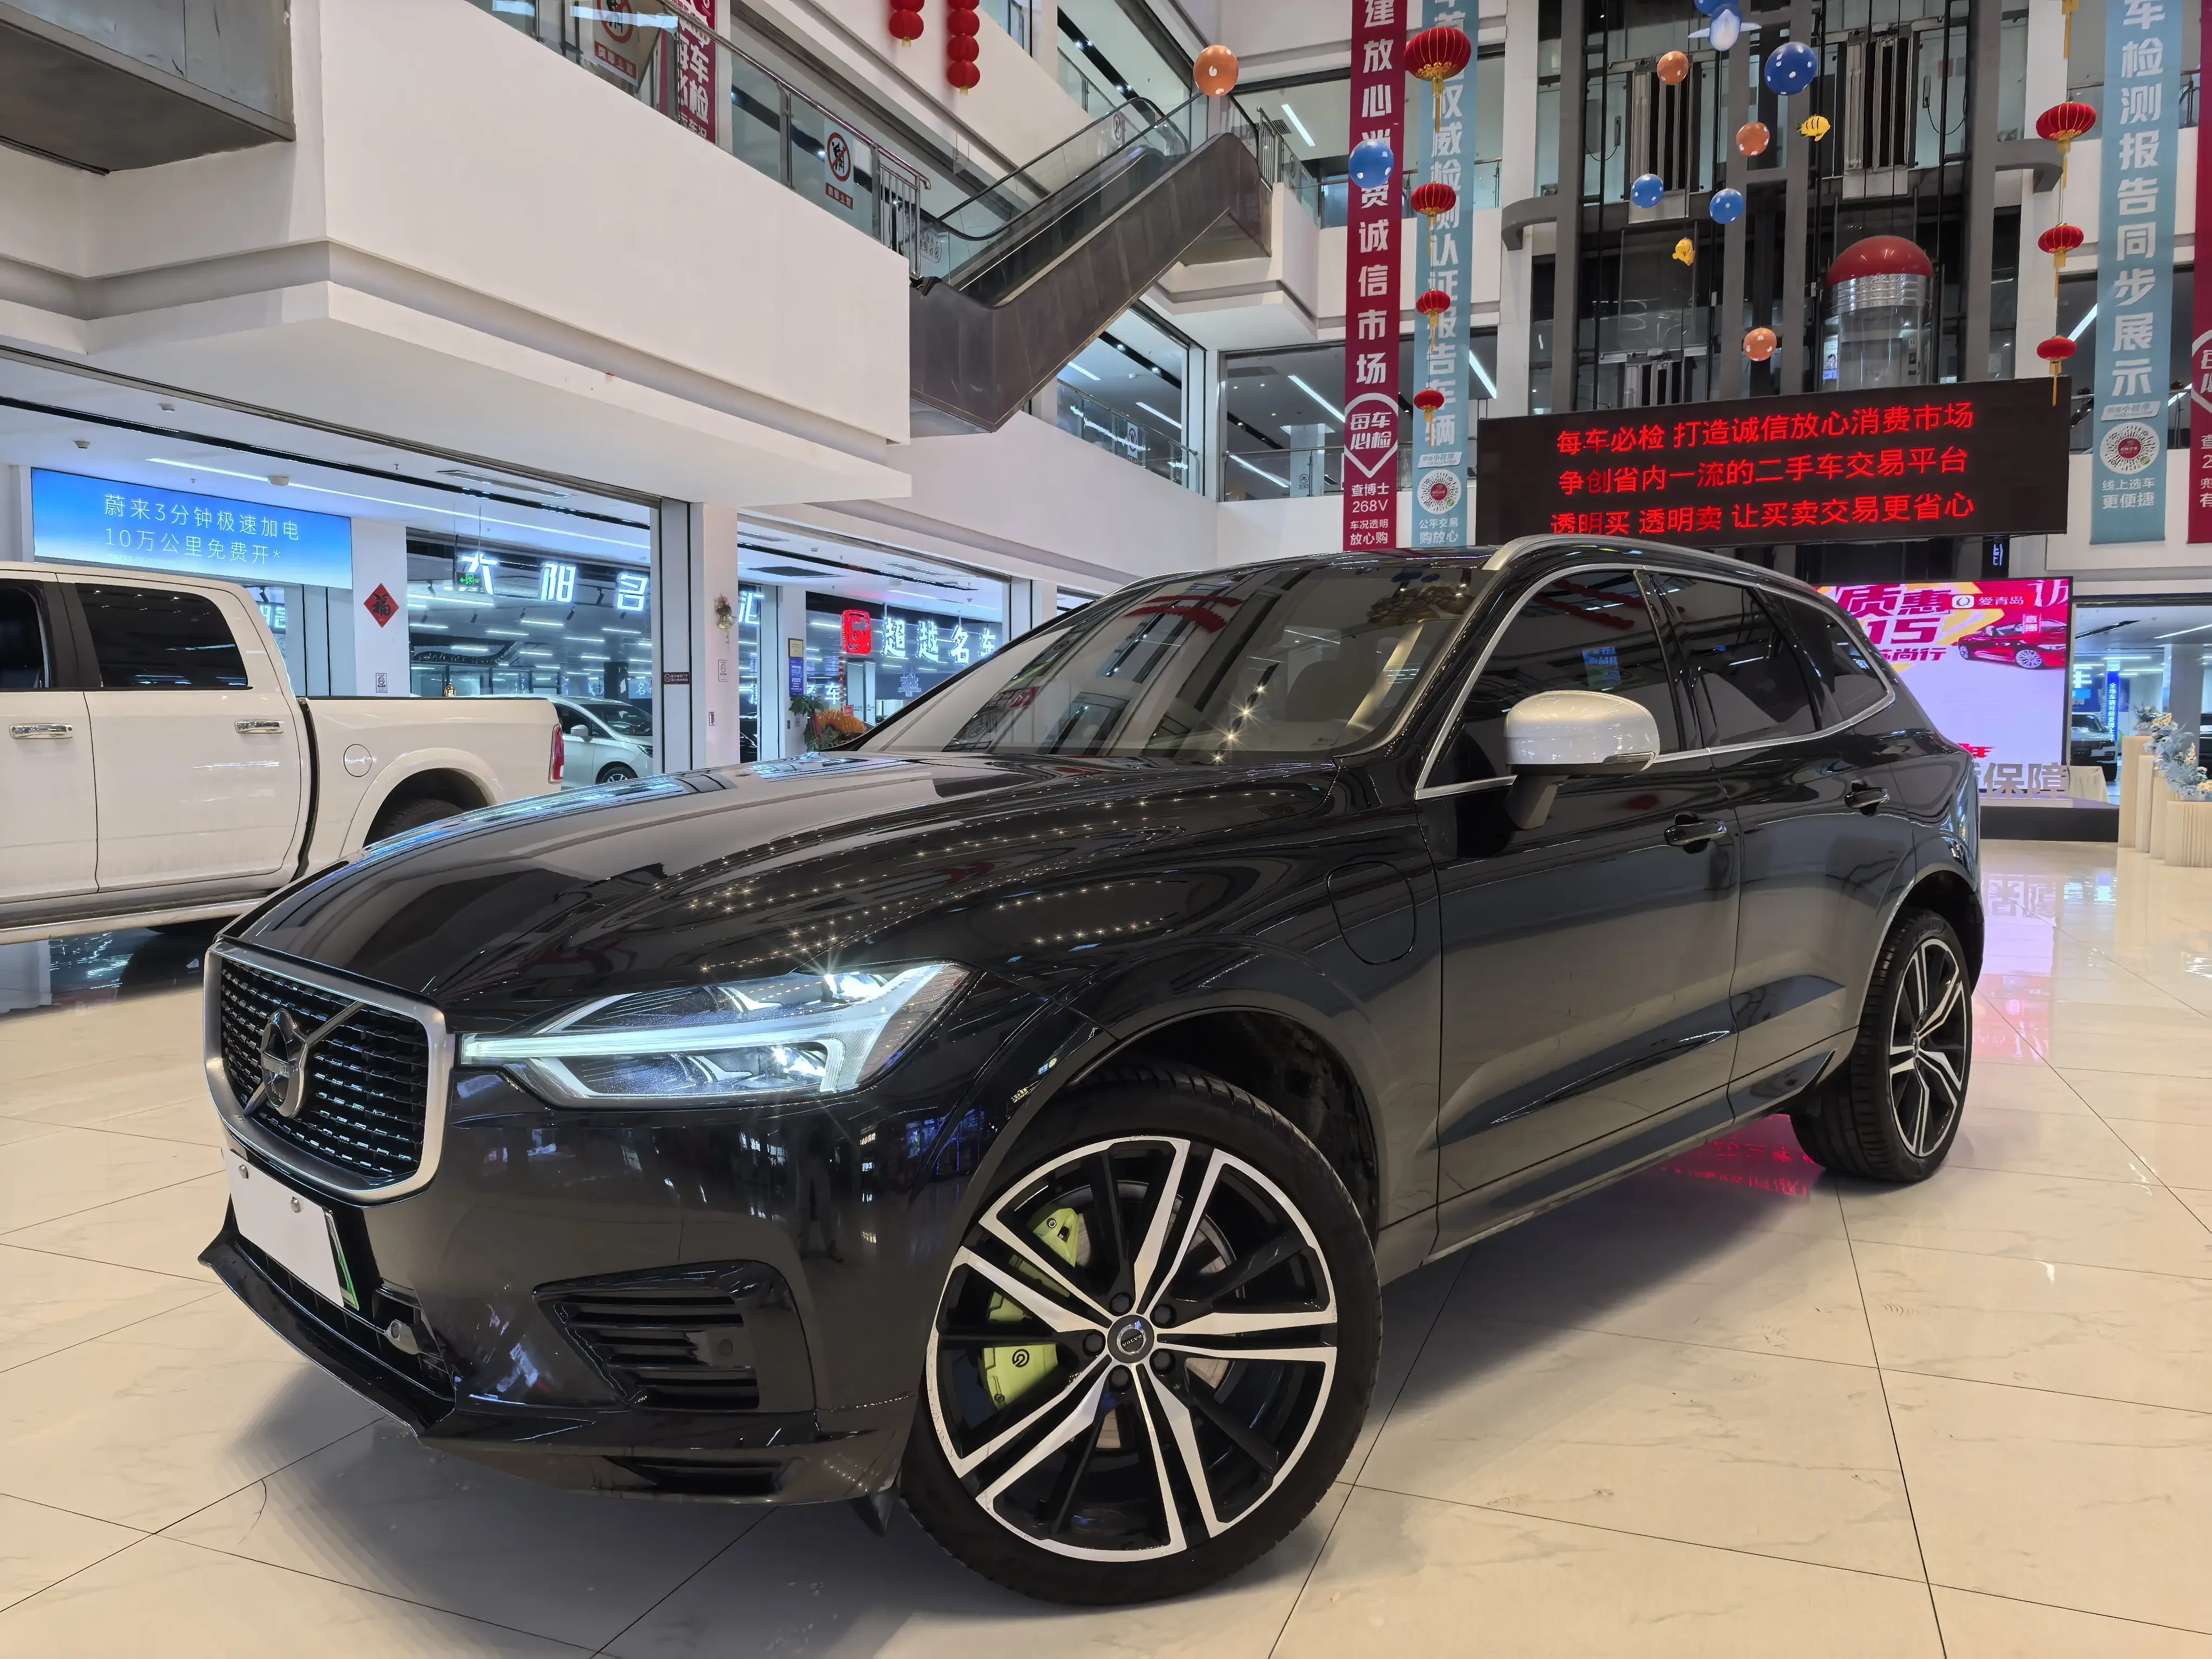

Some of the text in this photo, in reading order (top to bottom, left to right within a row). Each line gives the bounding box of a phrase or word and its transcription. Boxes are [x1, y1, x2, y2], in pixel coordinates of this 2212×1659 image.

[1351, 412, 1392, 431] 每车
[1557, 402, 1974, 455] 每车必检 打造诚信放心消费市场
[1350, 431, 1392, 450] 必检
[1559, 446, 1967, 495] 争创省内一流的二手车交易平台
[1351, 482, 1390, 497] 查博士
[2102, 477, 2155, 491] 线上选车
[1352, 500, 1388, 513] 268V
[2102, 491, 2155, 509] 更便捷
[104, 494, 299, 541] 蔚来3分钟极速加电
[1419, 517, 1458, 529] 公平交易
[1551, 492, 1975, 536] 透明买 透明卖 让买卖交易更省心
[1350, 519, 1388, 530] 车况透明
[1350, 531, 1388, 545] 放心购
[1419, 530, 1458, 544] 购放心
[880, 617, 996, 664] 超越名车
[1973, 763, 2070, 799] 保障
[1123, 1334, 1142, 1346] VOLVO
